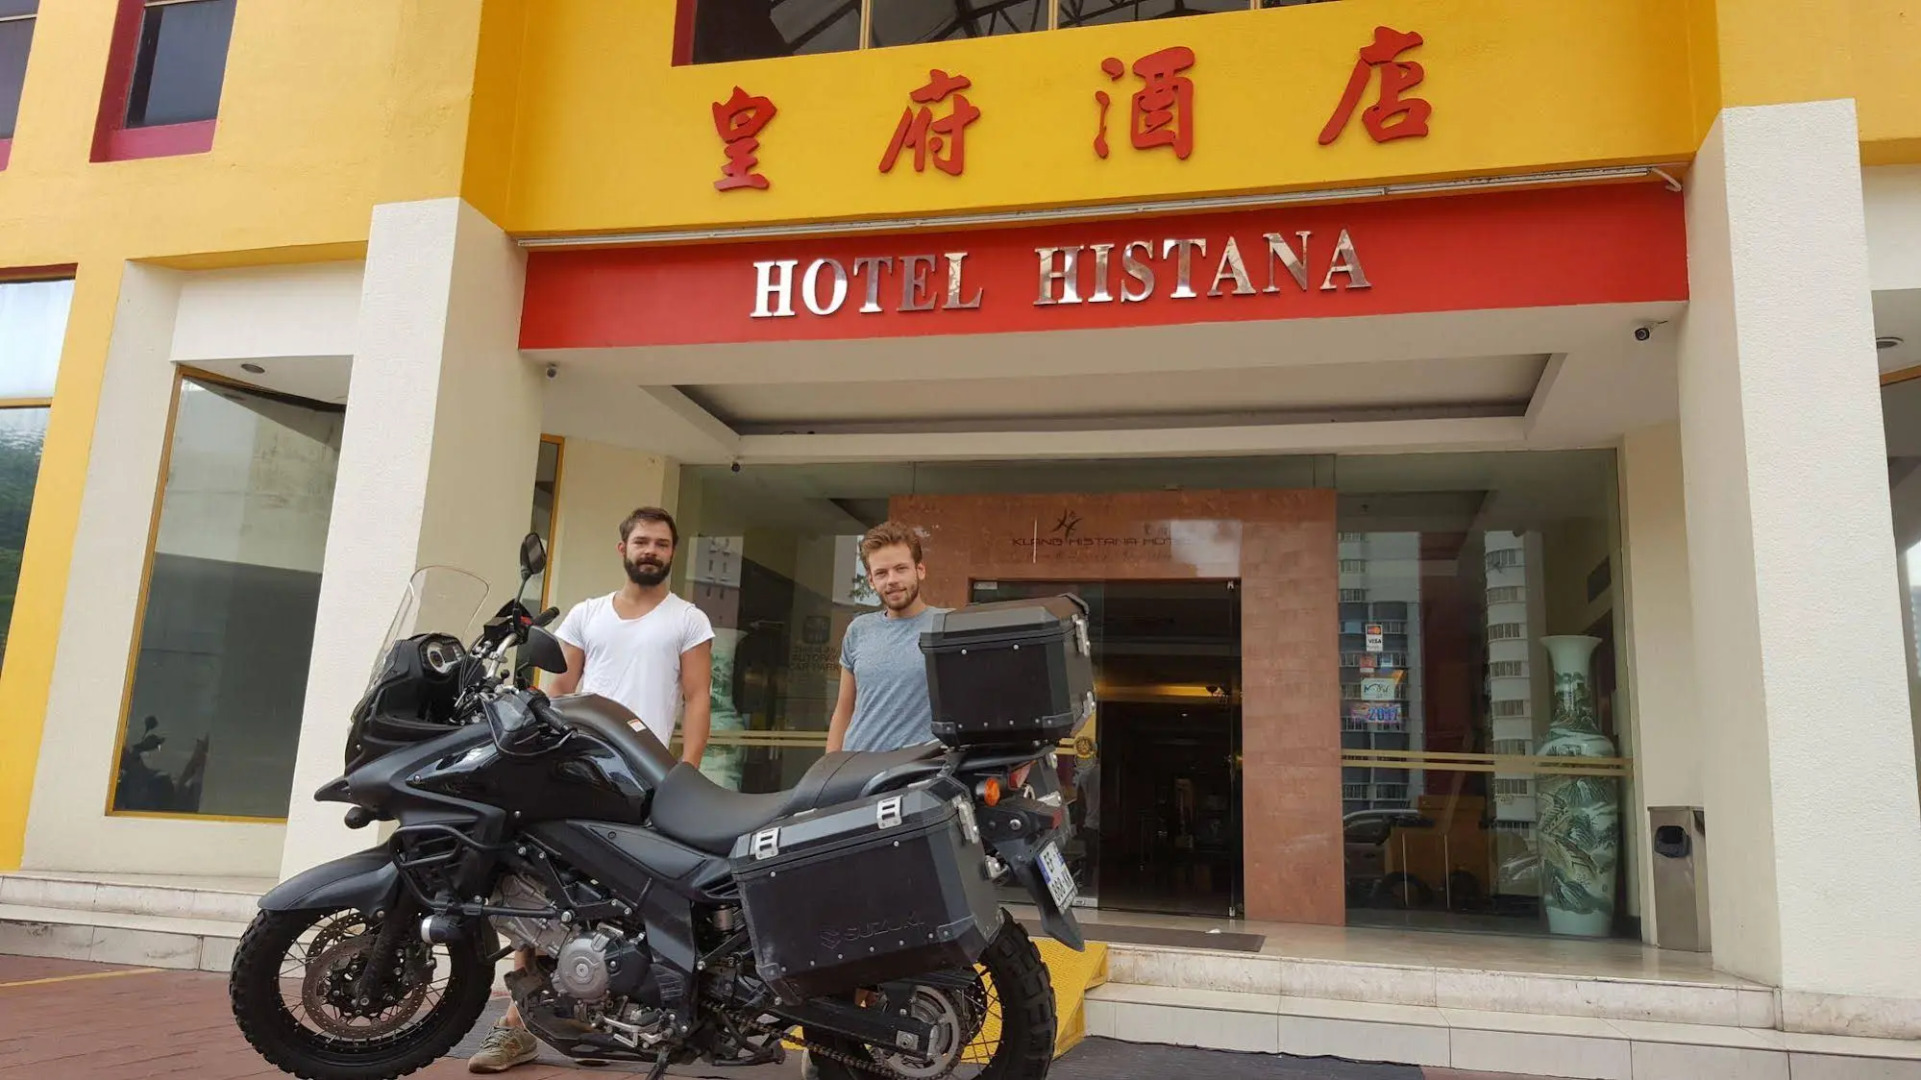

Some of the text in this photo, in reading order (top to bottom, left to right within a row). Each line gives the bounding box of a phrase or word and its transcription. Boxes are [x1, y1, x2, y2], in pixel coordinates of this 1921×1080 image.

[712, 25, 1433, 192] 皇府酒店
[750, 228, 1373, 319] HOTEL HISTANA
[1068, 538, 1137, 546] HISTANA
[1368, 706, 1399, 721] 2017
[843, 911, 926, 942] SUZUKI
